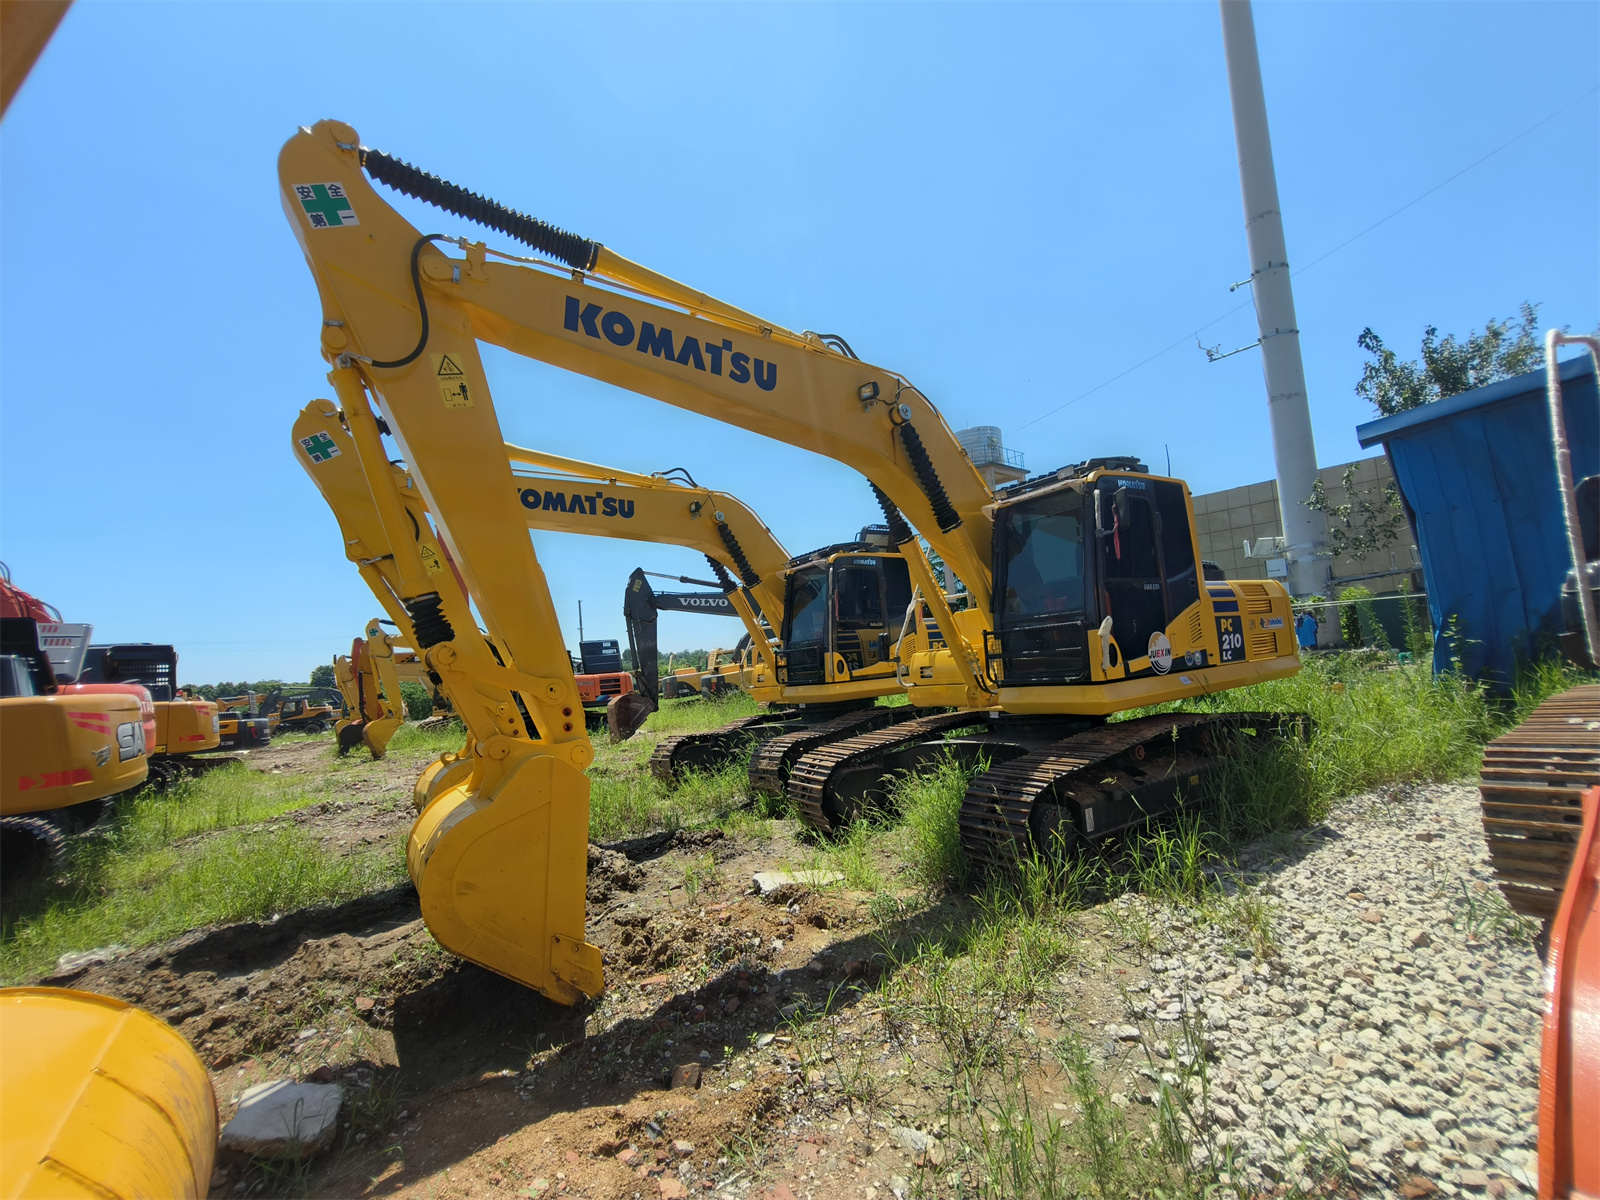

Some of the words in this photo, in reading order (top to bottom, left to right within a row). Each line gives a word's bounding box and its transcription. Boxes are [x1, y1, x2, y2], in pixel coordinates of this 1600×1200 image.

[563, 295, 778, 392] KOMATSU
[517, 488, 635, 519] OMATSU
[678, 597, 729, 607] VOLVO
[1220, 618, 1233, 633] PC
[932, 641, 944, 649] PC
[1222, 633, 1242, 650] 210
[1148, 647, 1171, 659] JUEXIN
[1222, 651, 1232, 661] LC
